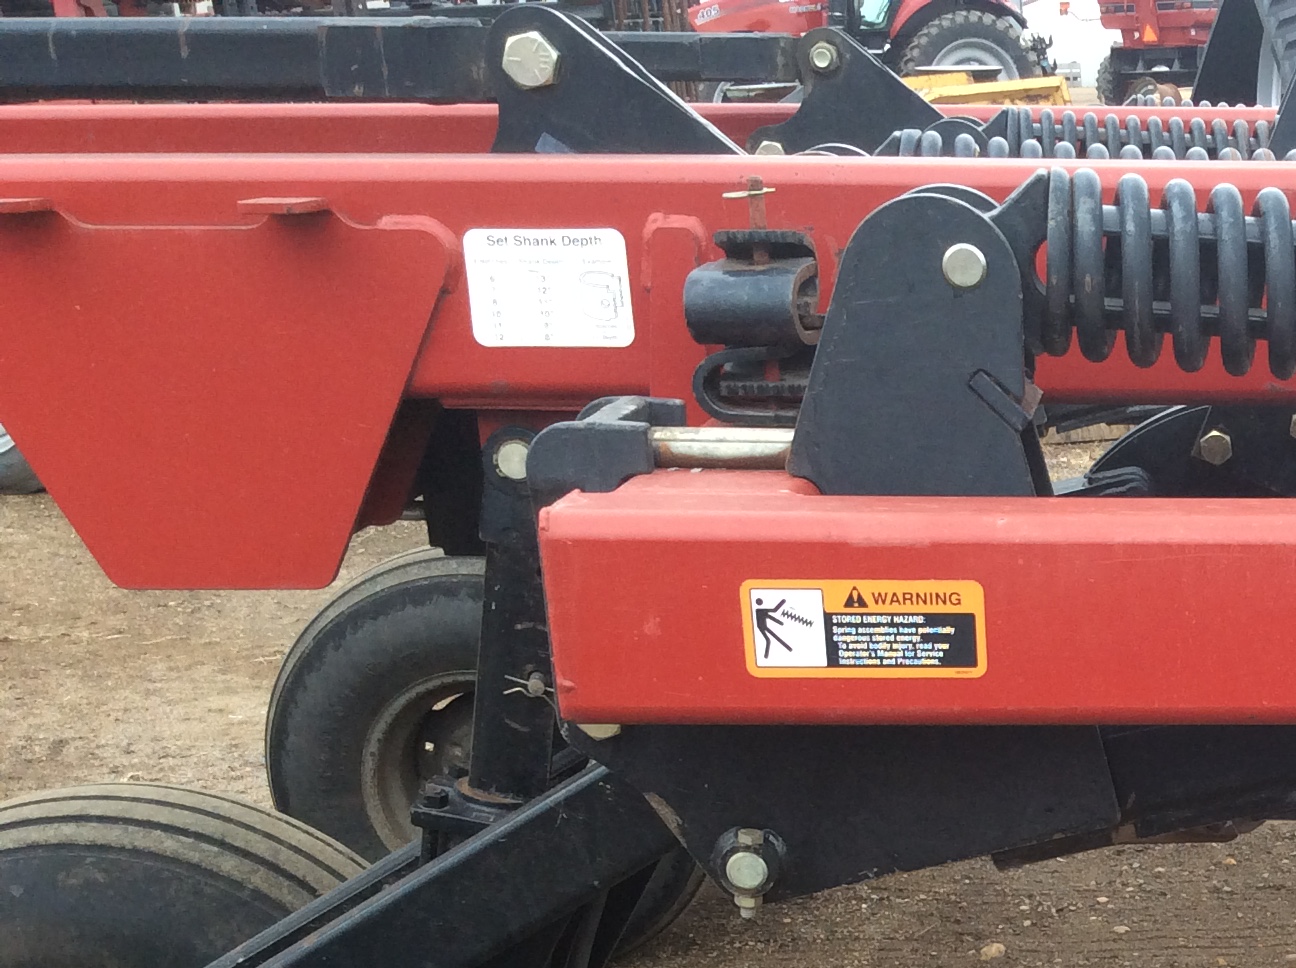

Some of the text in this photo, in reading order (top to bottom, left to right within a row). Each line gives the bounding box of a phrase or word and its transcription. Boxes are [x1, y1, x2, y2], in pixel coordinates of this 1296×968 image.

[486, 234, 603, 248] Set Shank Depth
[871, 592, 962, 606] WARNING
[832, 615, 861, 624] STORED
[863, 615, 892, 624] ENERGY
[832, 626, 955, 635] Spring assemblies have potentially
[832, 634, 870, 643] dangerous
[872, 634, 895, 642] stored
[848, 642, 868, 650] avoid
[869, 642, 891, 650] bodily
[916, 642, 933, 650] read
[838, 650, 876, 658] Operator's
[877, 650, 904, 658] Manual
[916, 650, 944, 658] Service
[838, 658, 881, 666] Instructions
[882, 658, 896, 666] and
